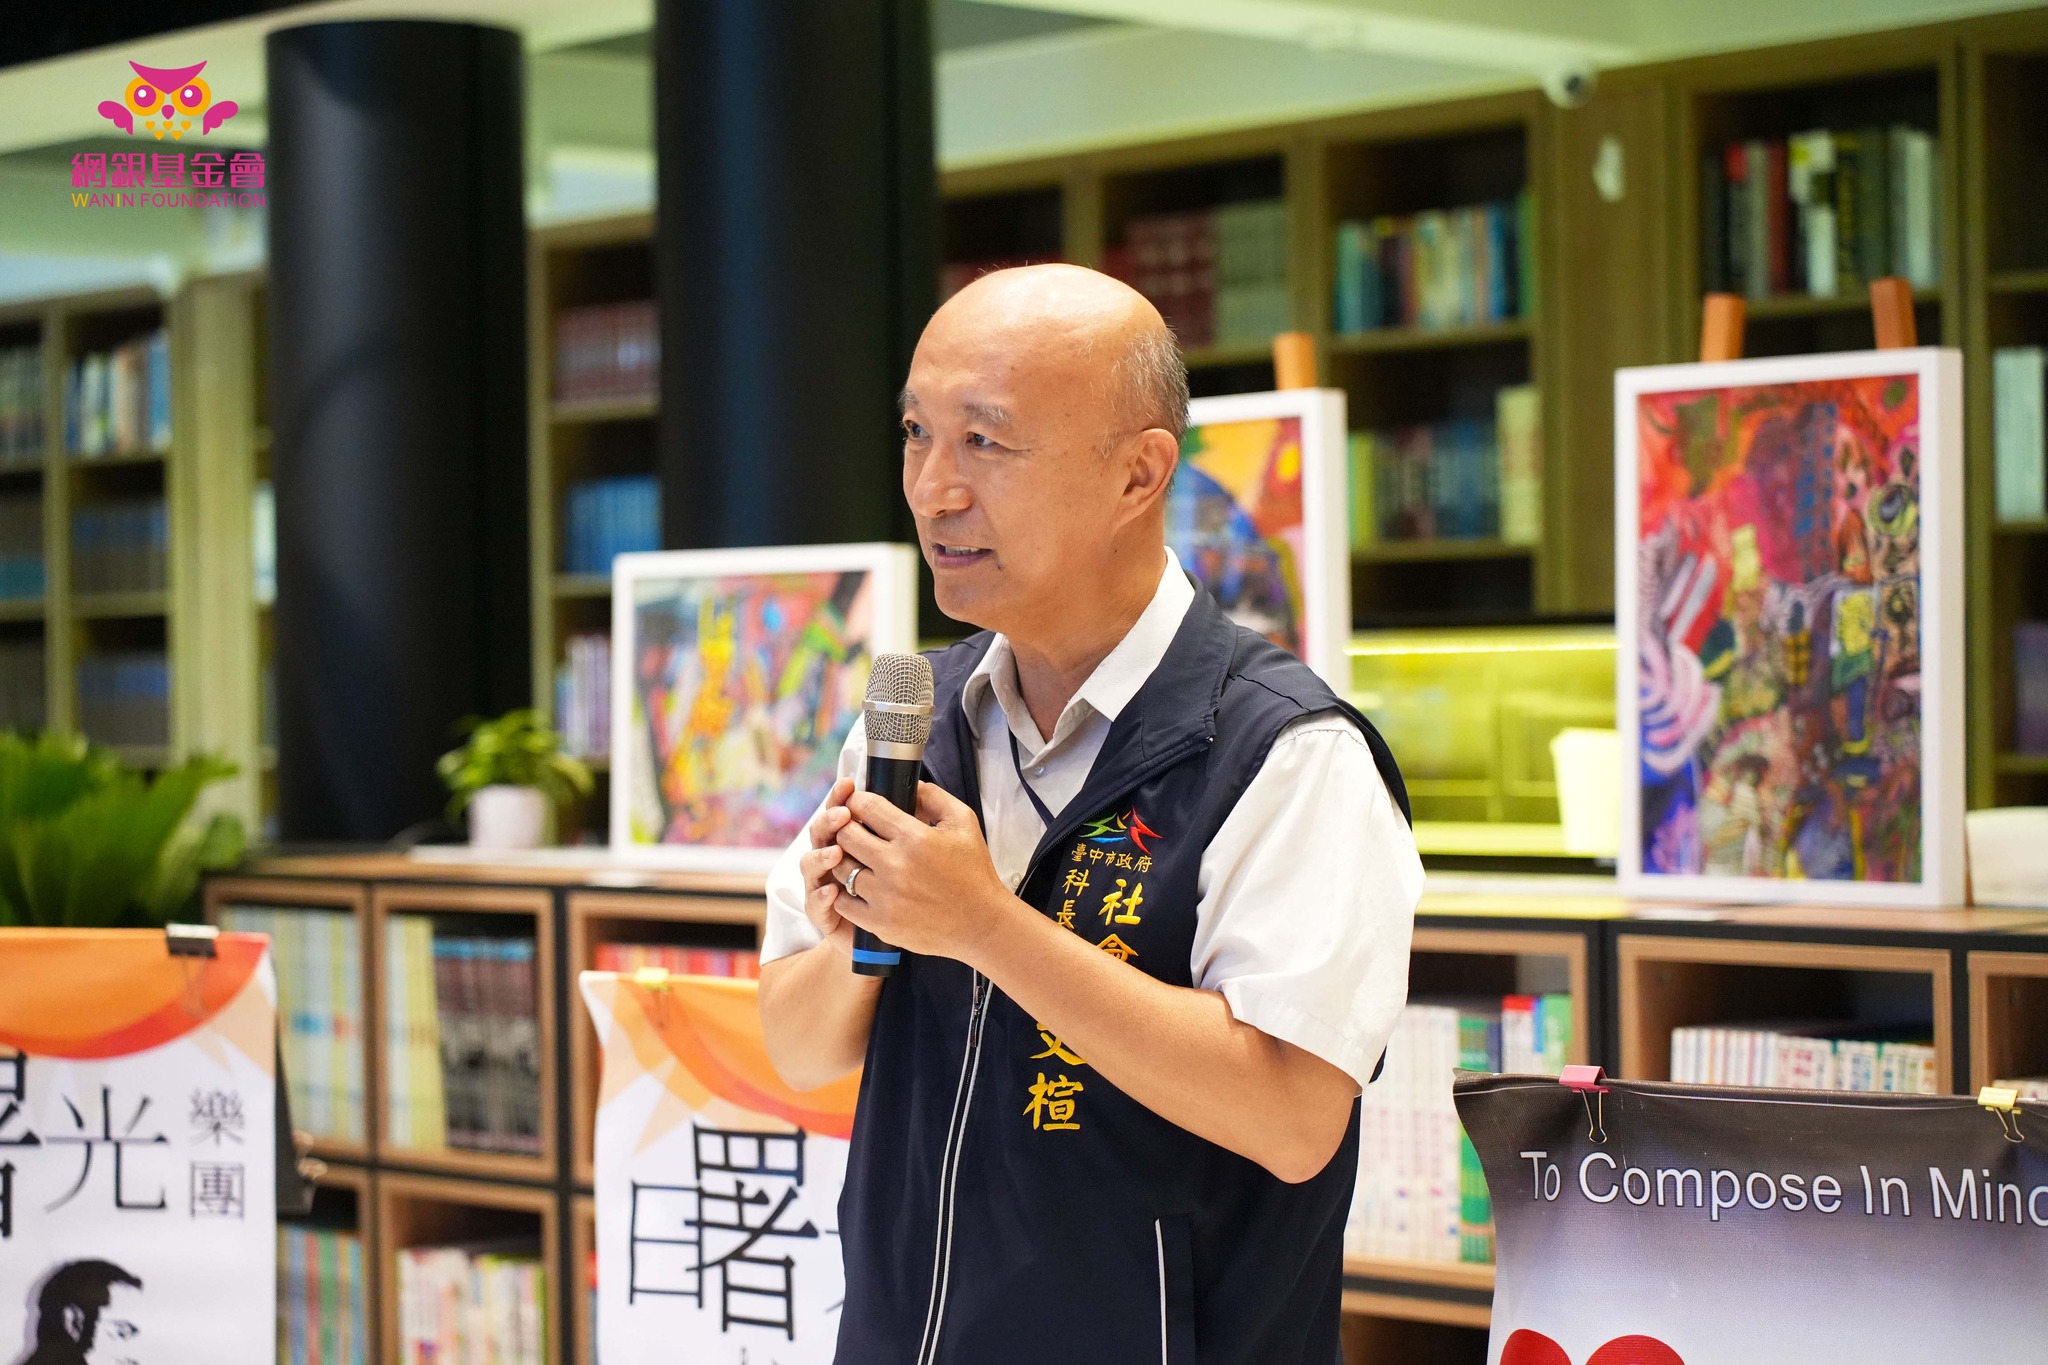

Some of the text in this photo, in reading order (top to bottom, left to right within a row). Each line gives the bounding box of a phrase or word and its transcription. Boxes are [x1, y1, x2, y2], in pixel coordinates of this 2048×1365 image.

[1071, 843, 1153, 873] 臺中市政府
[1056, 868, 1090, 930] 科長
[190, 1087, 245, 1221] 樂團
[1519, 1151, 1561, 1202] To
[1579, 1151, 1842, 1221] Compose
[1860, 1165, 1910, 1217] In
[629, 1121, 844, 1342] 曙
